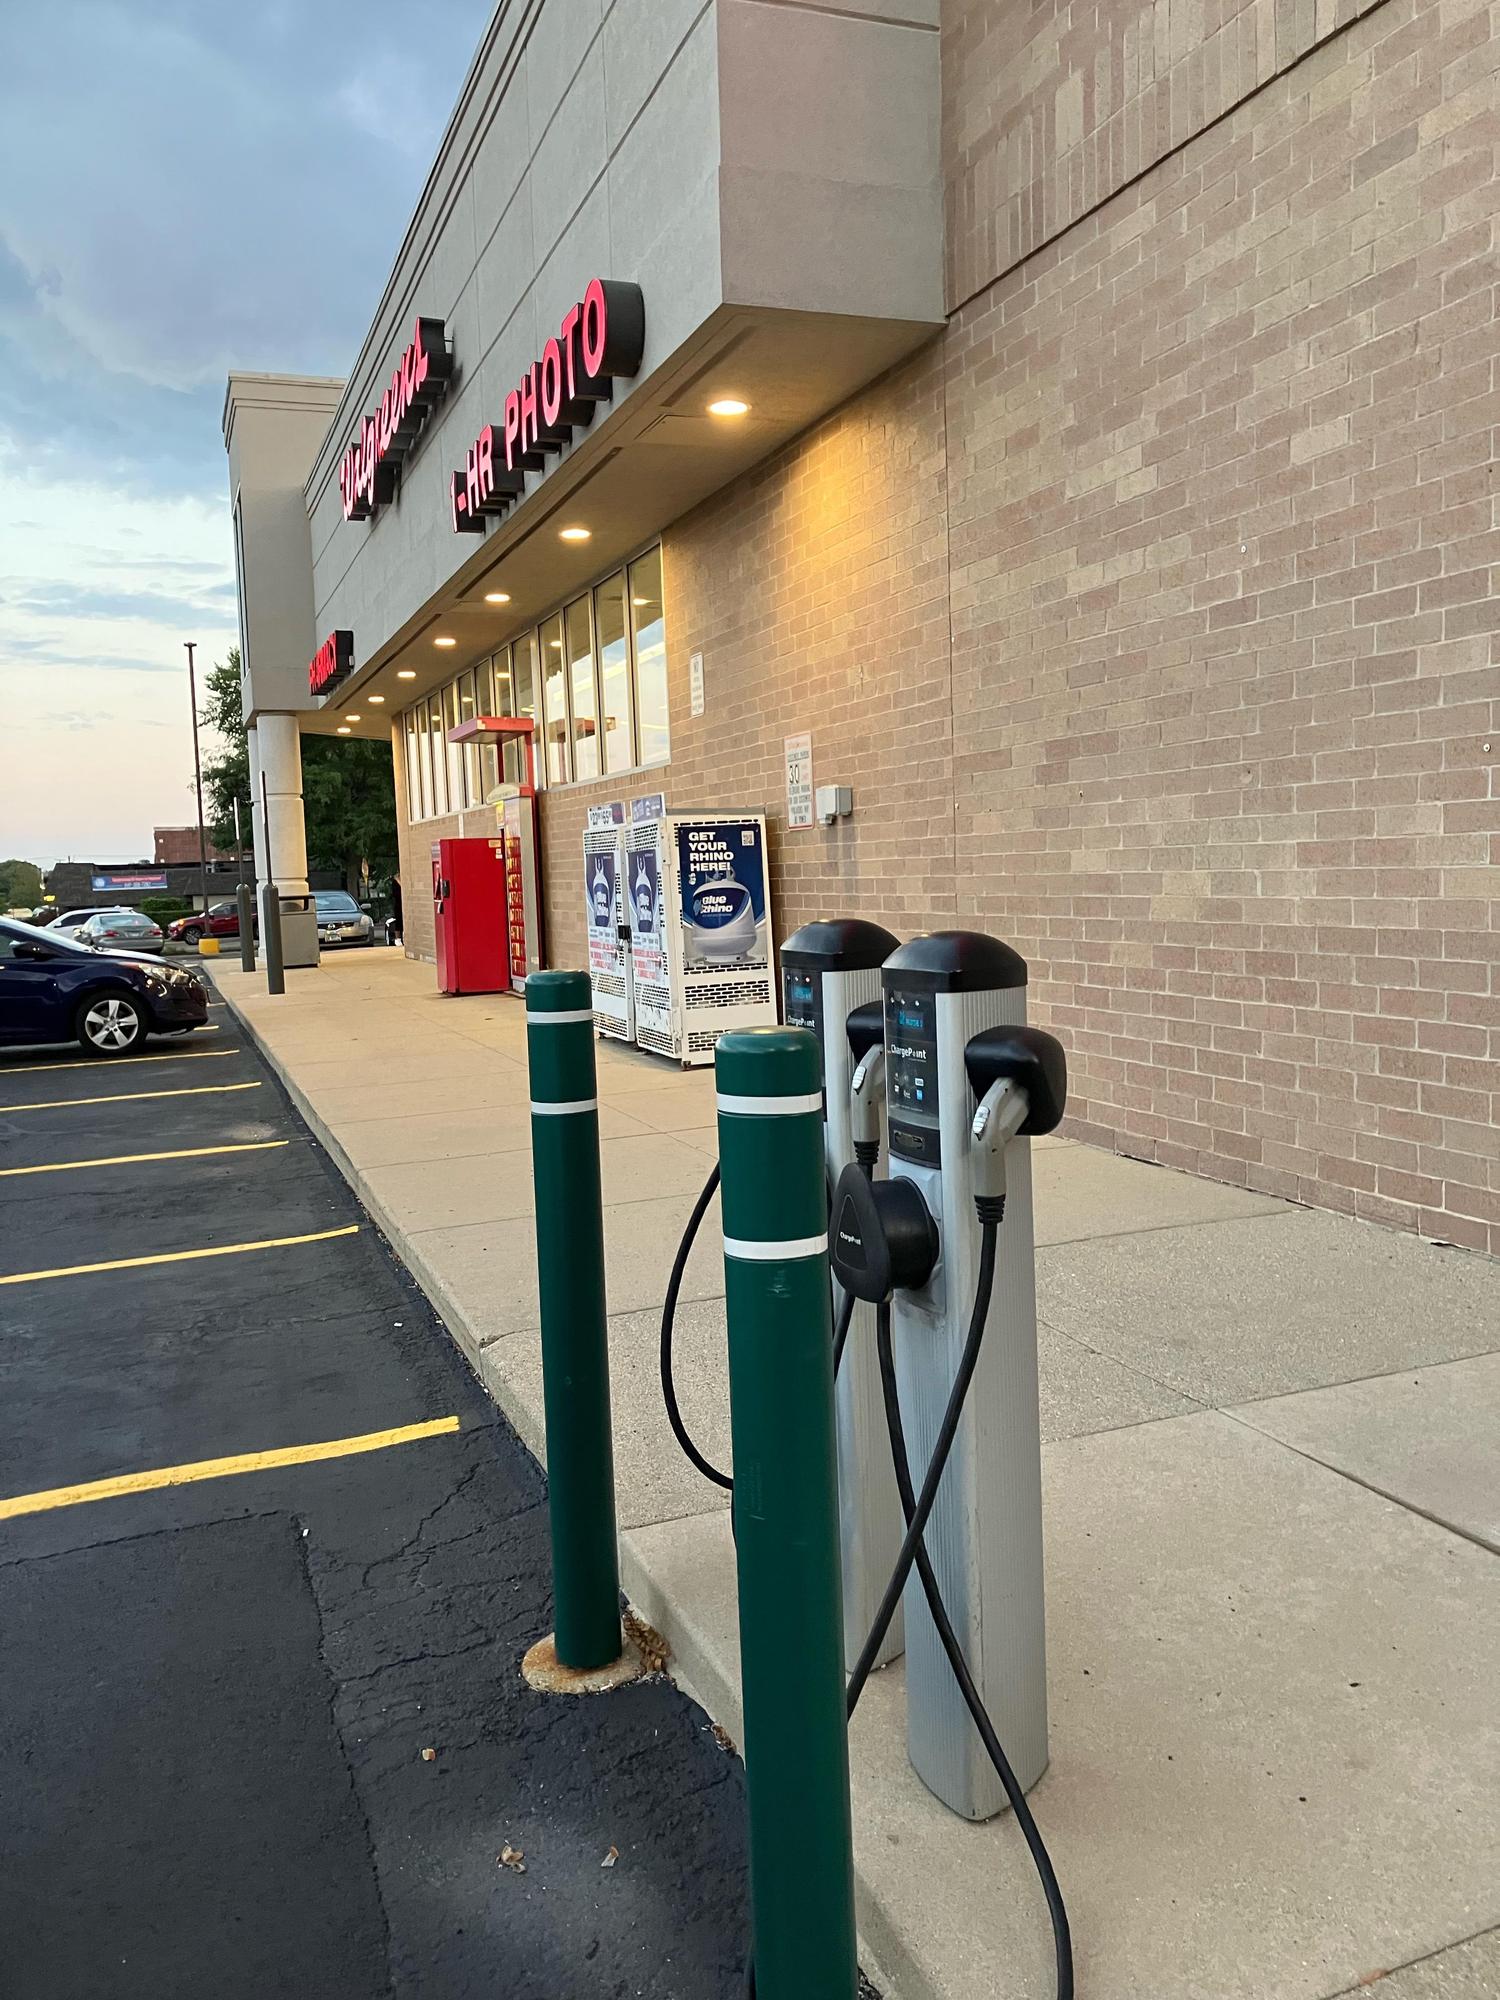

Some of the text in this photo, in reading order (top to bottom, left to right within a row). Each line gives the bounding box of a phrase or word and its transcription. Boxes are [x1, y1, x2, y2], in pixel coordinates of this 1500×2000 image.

[450, 278, 607, 533] 1-HR PHOTO
[789, 764, 800, 785] 30
[688, 831, 716, 842] GET
[688, 841, 728, 852] YOUR
[689, 851, 734, 862] RHINO
[690, 861, 731, 872] HERE!
